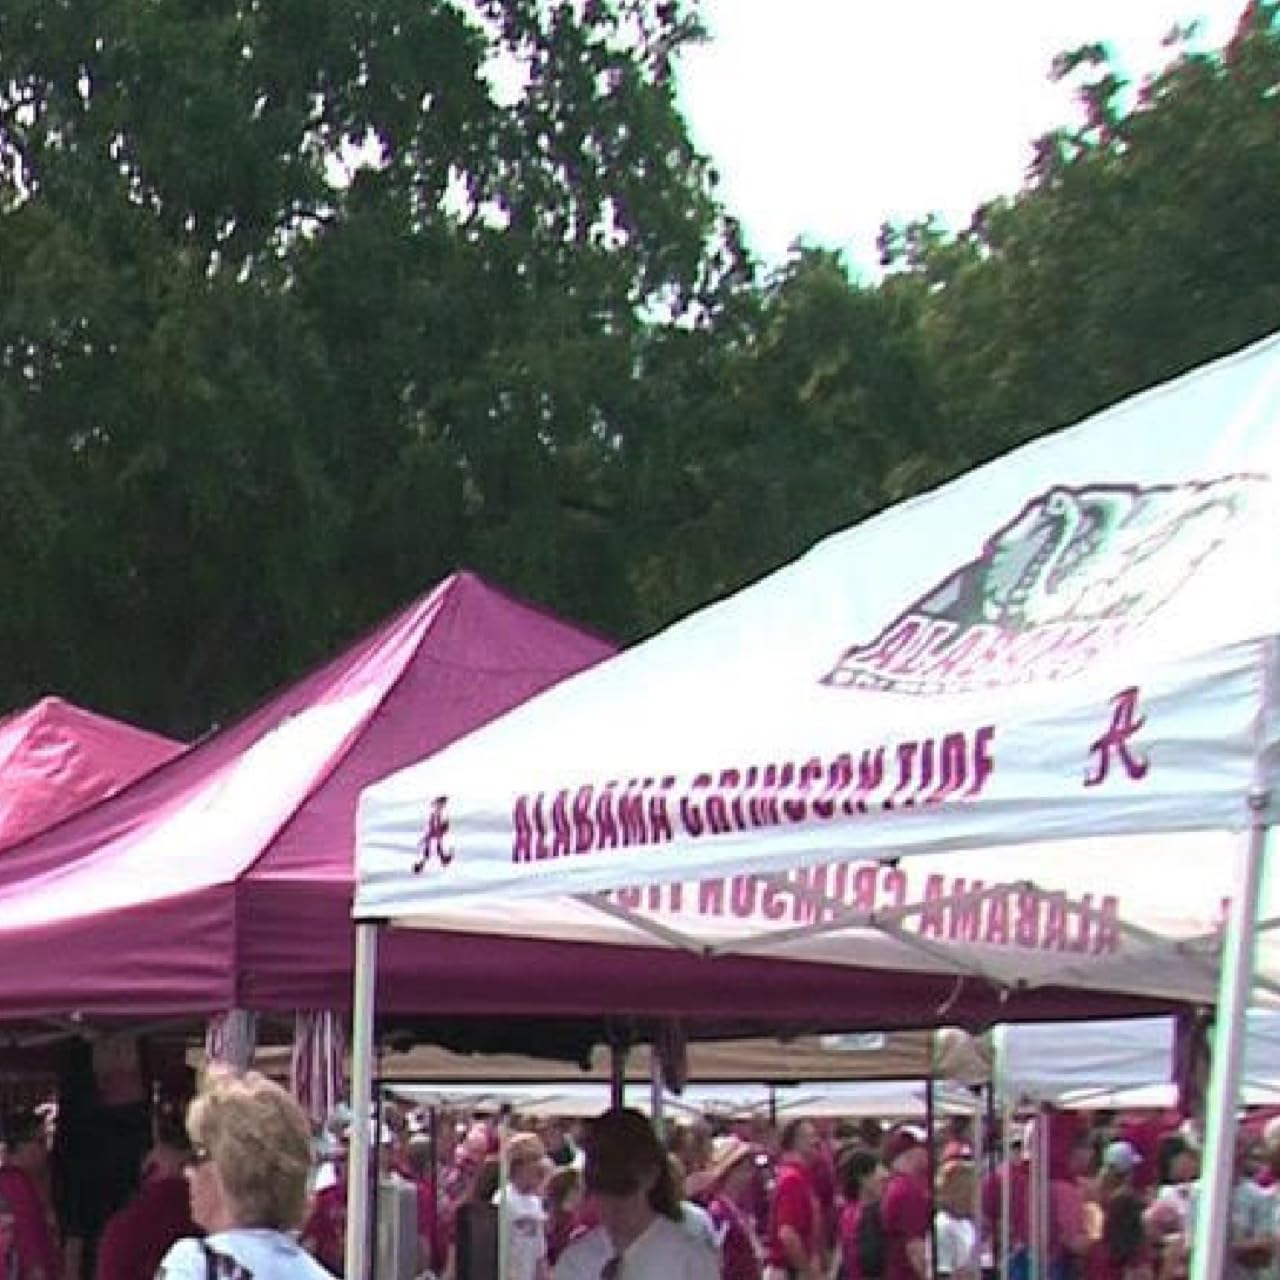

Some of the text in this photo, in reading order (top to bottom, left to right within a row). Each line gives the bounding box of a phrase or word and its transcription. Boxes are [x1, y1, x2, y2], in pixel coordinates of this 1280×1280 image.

[512, 724, 997, 864] ALABAMA CRIMSON TIDE
